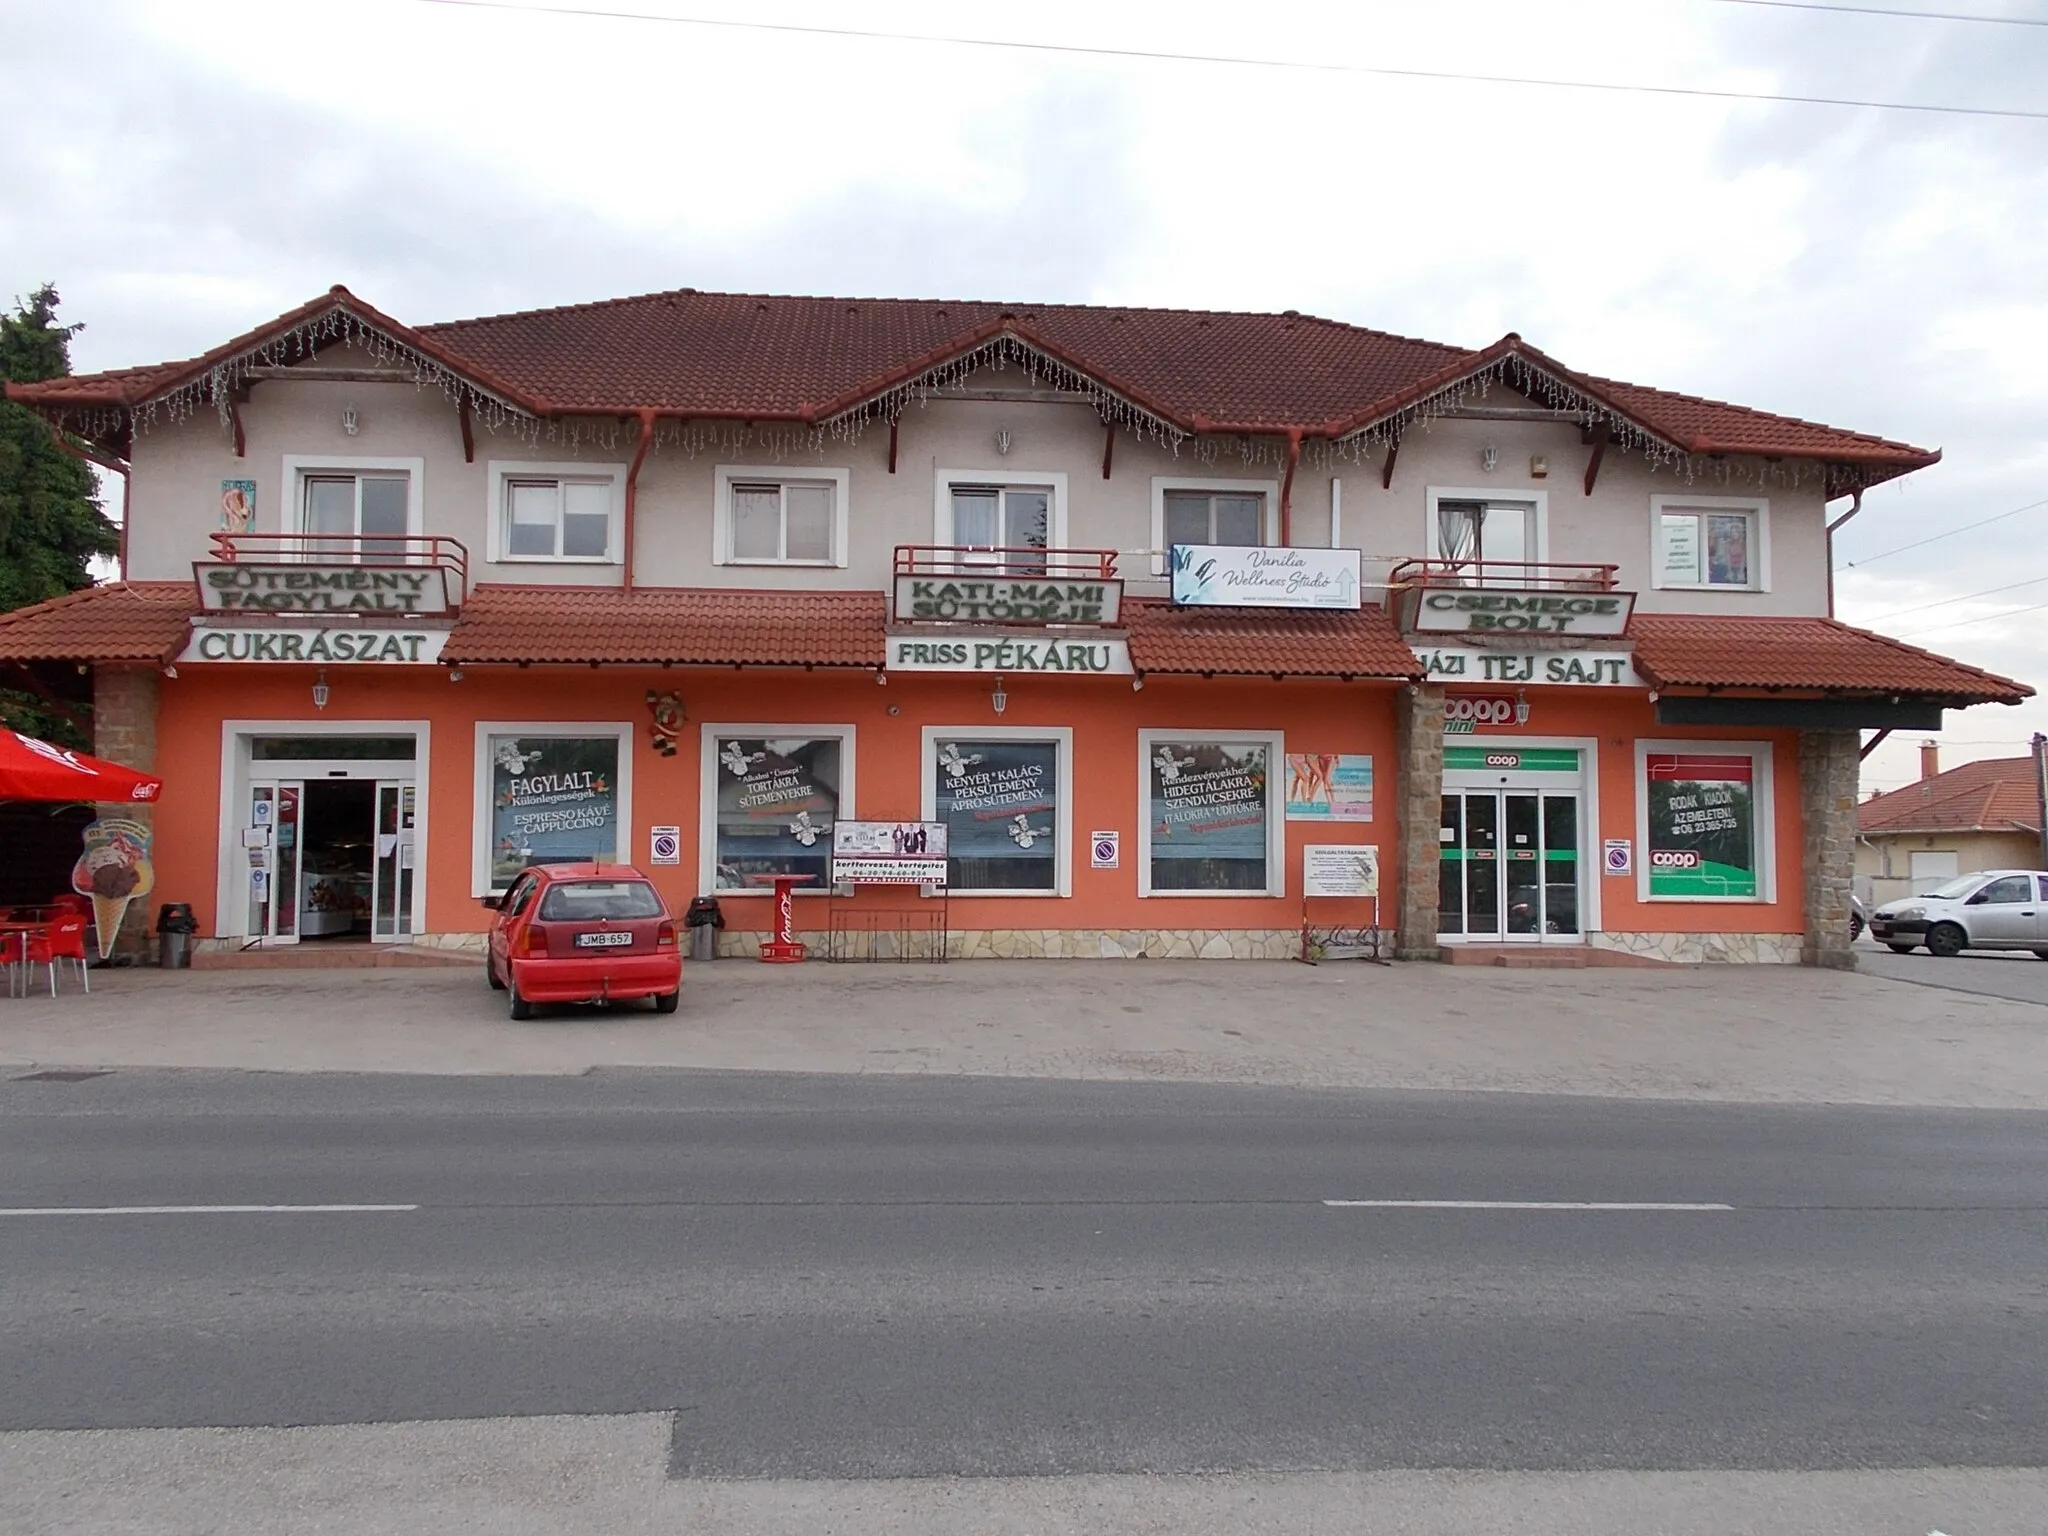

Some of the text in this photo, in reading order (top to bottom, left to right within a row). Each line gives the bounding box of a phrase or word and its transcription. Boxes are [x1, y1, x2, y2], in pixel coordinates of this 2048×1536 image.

[1247, 551, 1307, 568] Vanilia
[208, 566, 429, 590] SÜTEMÉNY
[1222, 569, 1286, 587] Wellness
[219, 591, 421, 611] FAGYLALT
[912, 581, 1104, 602] KATI-MAMI
[1426, 594, 1620, 615] CSEMEGE
[1468, 614, 1574, 632] BOLT
[199, 628, 427, 662] CUKRÁSZAT
[898, 636, 1111, 671] FRISS PÉKÁRU
[1478, 655, 1535, 681] TEJ
[1546, 658, 1627, 684] SAJT
[1444, 699, 1511, 725] coop
[1487, 756, 1517, 767] coop
[510, 771, 593, 796] FAGYLALT
[747, 776, 799, 793] TORTÁKRA
[946, 765, 1043, 789] KENYÉR KALÁCS
[1161, 767, 1249, 786] Rendezvényekhez
[739, 785, 815, 808] SÜTEMÉNYEKRE
[955, 778, 1038, 799] PÉKSÜTEMÉNY
[1163, 776, 1253, 798] HIDEGTÁLAKRA
[512, 789, 596, 807] Különlegességek
[951, 797, 982, 812] APRÓ
[984, 788, 1044, 807] SÜTEMÉNY
[1165, 787, 1256, 810] SZENDVICSEKRE
[514, 803, 612, 826] ESPRESSO KÁVÉ
[1164, 808, 1210, 824] ITALOKRA
[1675, 812, 1686, 825] AZ
[524, 817, 604, 834] CAPPUCCINO
[1680, 818, 1737, 834] 06 23 365-735
[898, 861, 944, 869] kertépítés
[1653, 853, 1695, 868] coop
[584, 934, 629, 945] JMB-657
